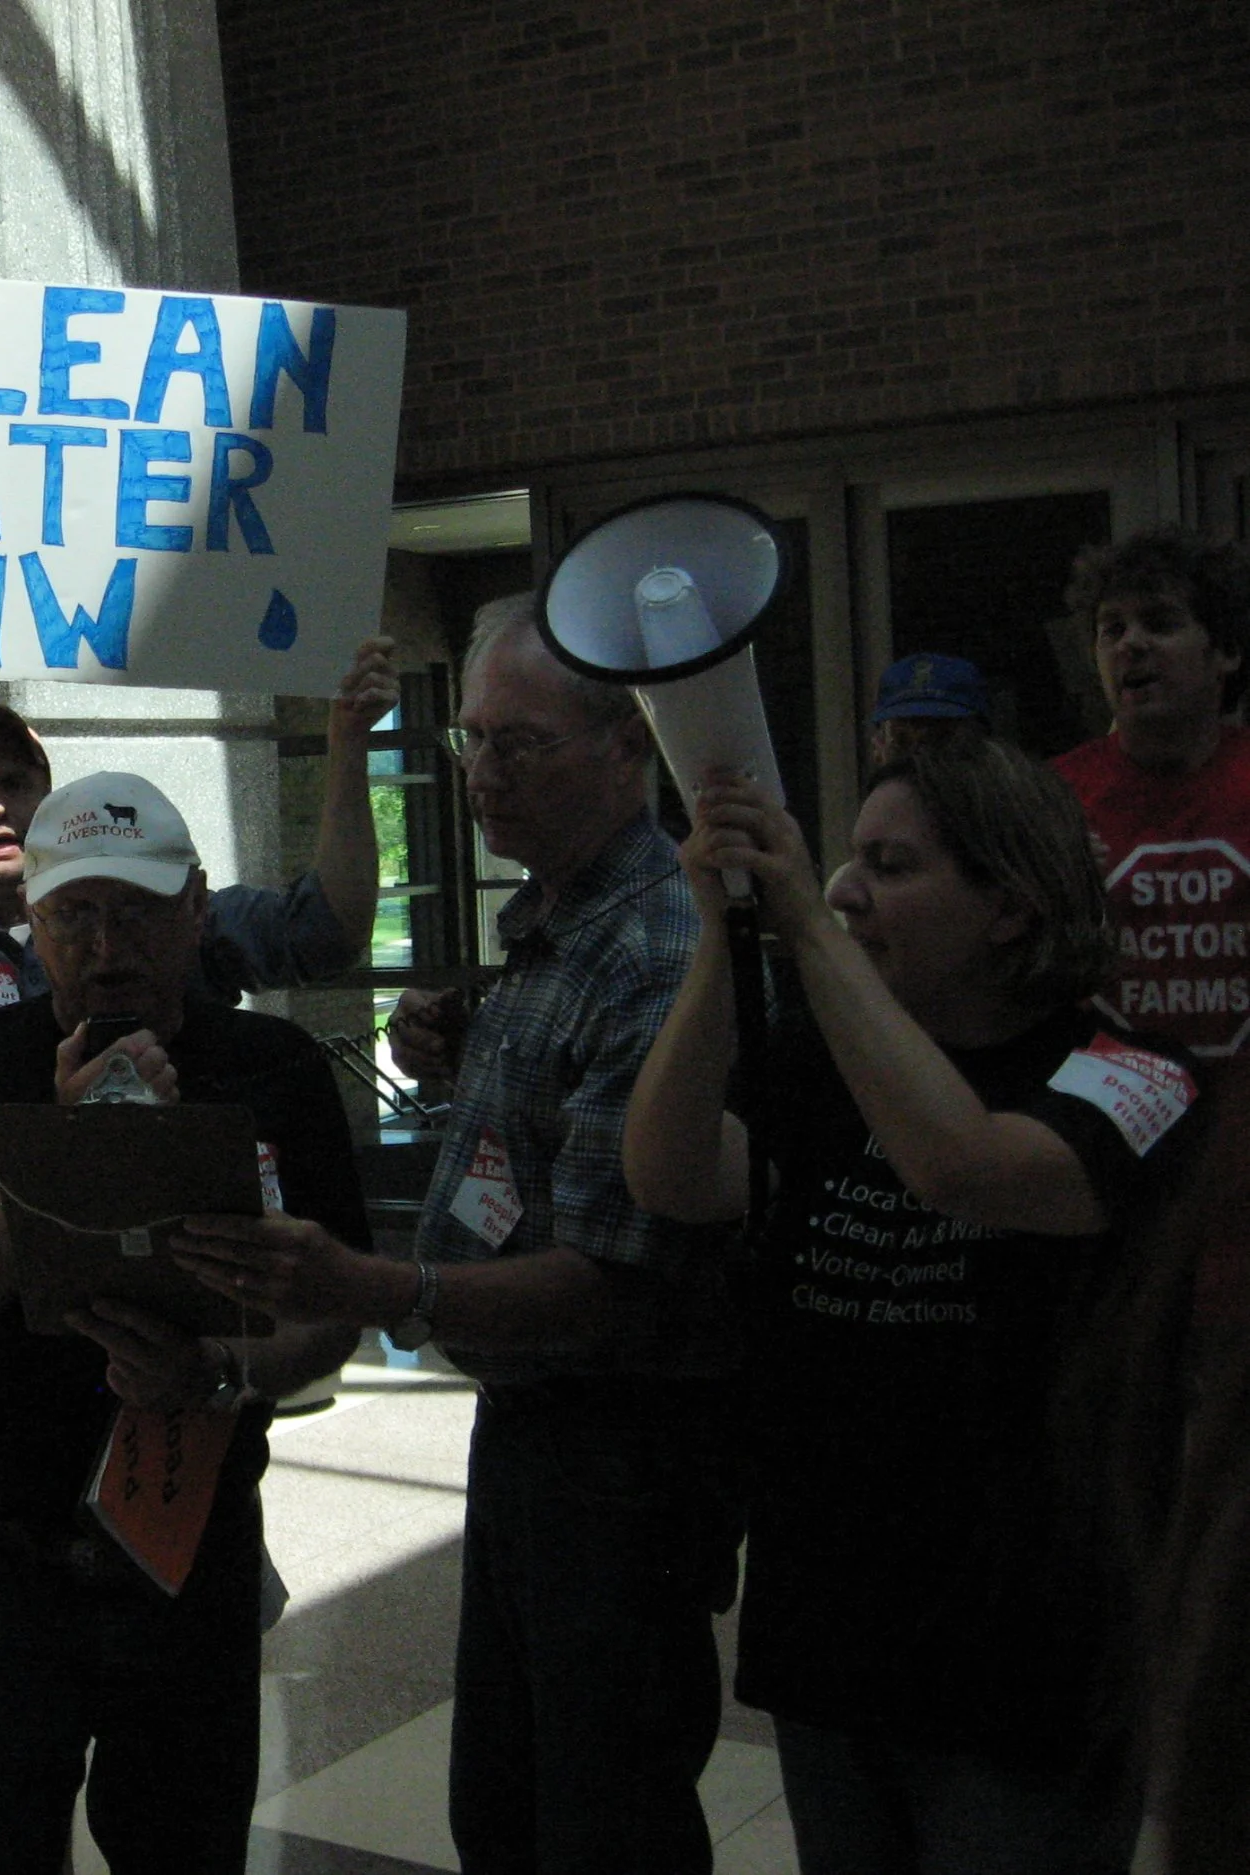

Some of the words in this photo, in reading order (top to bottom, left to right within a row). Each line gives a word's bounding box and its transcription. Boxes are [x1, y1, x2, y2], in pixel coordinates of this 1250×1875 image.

[57, 825, 145, 845] LIVESTOCK
[62, 811, 98, 832] TAMA
[1130, 868, 1233, 906] STOP
[1119, 922, 1250, 960] ACTOR
[1120, 977, 1250, 1014] FARMS
[837, 1176, 896, 1212] Loca
[823, 1212, 895, 1249] Clean
[791, 1283, 860, 1321] Clean
[866, 1298, 979, 1326] Elections
